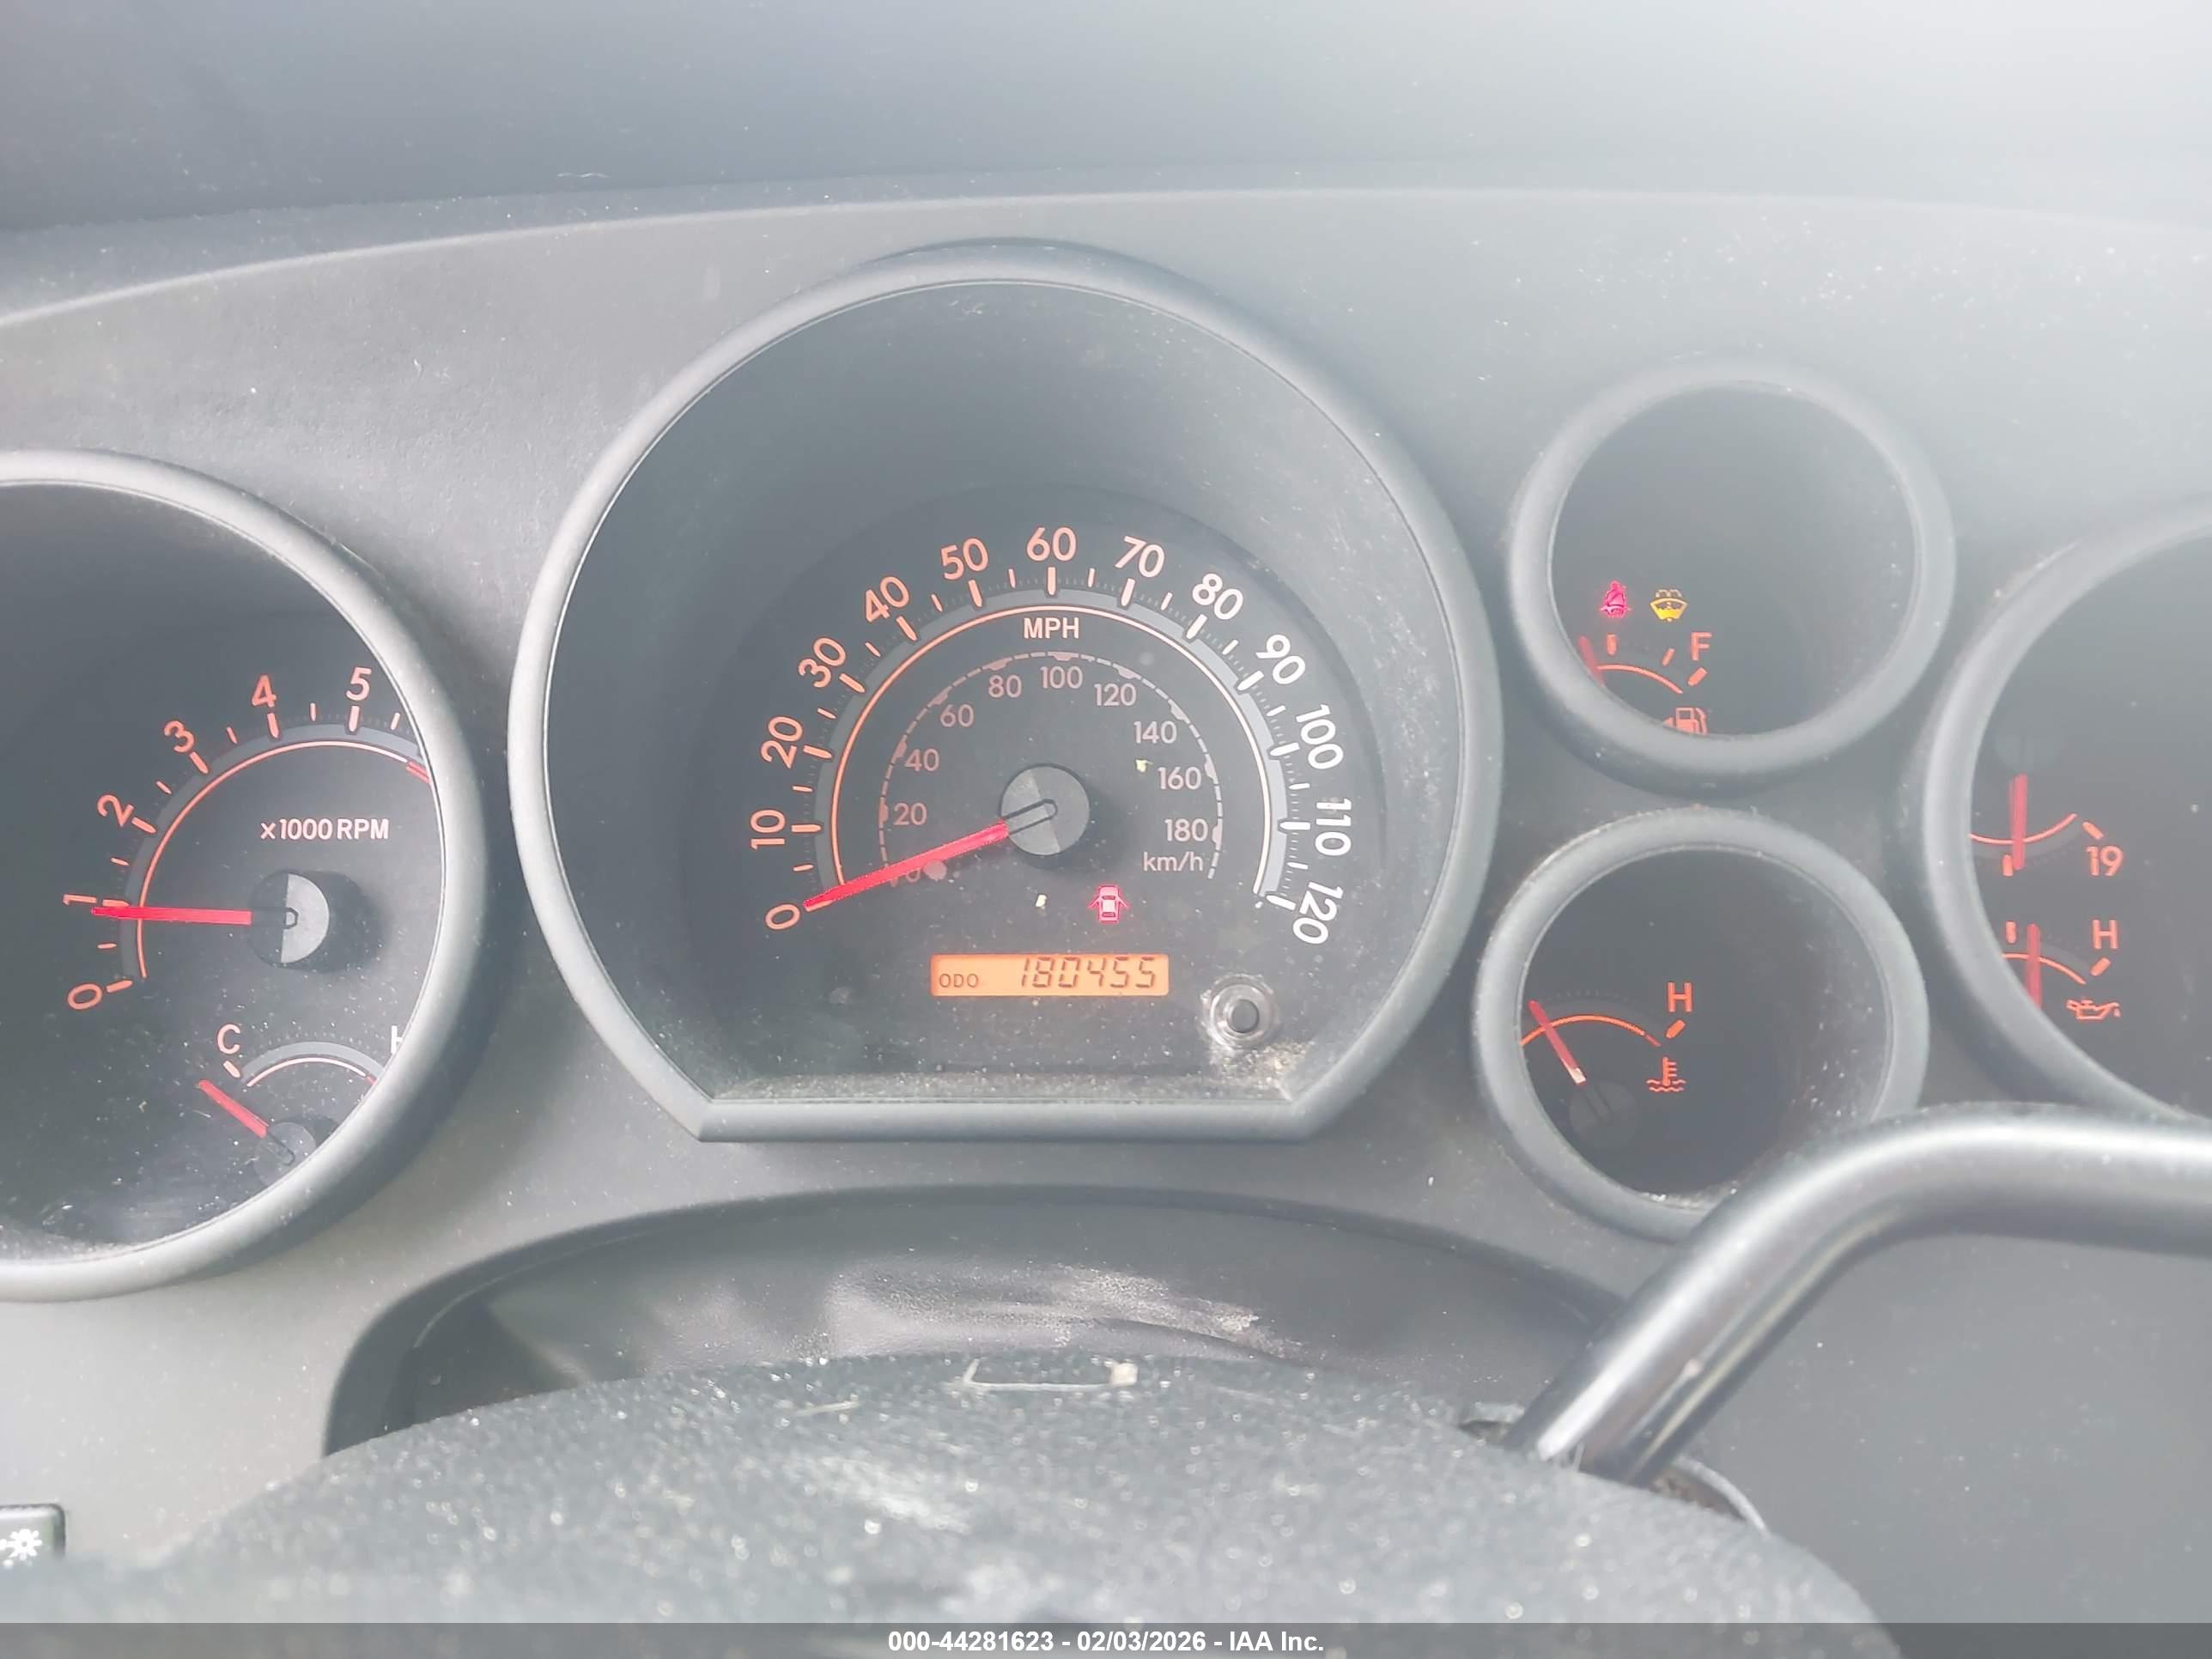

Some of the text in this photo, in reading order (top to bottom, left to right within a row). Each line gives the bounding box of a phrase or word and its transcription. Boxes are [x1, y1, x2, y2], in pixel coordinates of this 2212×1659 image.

[940, 538, 988, 580] 50
[1026, 526, 1076, 562] 60
[1115, 536, 1165, 578] 70
[865, 576, 909, 623] 40
[1192, 574, 1243, 620] 80
[1024, 617, 1079, 639] MPH
[1255, 634, 1305, 684] 90
[1691, 631, 1712, 661] F
[798, 637, 847, 688] 30
[1040, 665, 1083, 689] 100
[251, 674, 276, 708] 4
[346, 666, 372, 701] 5
[988, 674, 1022, 698] 80
[1094, 684, 1137, 707] 120
[940, 703, 975, 728] 60
[163, 720, 195, 753] 3
[761, 716, 803, 769] 20
[1133, 720, 1177, 744] 140
[1296, 704, 1343, 769] 100
[904, 749, 939, 771] 40
[1158, 767, 1201, 790] 160
[96, 793, 134, 827] 2
[893, 802, 927, 825] 20
[337, 818, 389, 840] RPM
[750, 810, 786, 849] 10
[1164, 818, 1208, 842] 180
[1315, 799, 1352, 856] 110
[1143, 851, 1203, 872] km/h
[2087, 845, 2124, 877] 19
[63, 894, 97, 906] 1
[1292, 881, 1344, 945] 120
[765, 903, 800, 930] 0
[2092, 919, 2118, 950] H
[939, 957, 1156, 988] ODO 180455
[67, 982, 103, 1010] 0
[1667, 981, 1693, 1012] H
[217, 1024, 240, 1054] C
